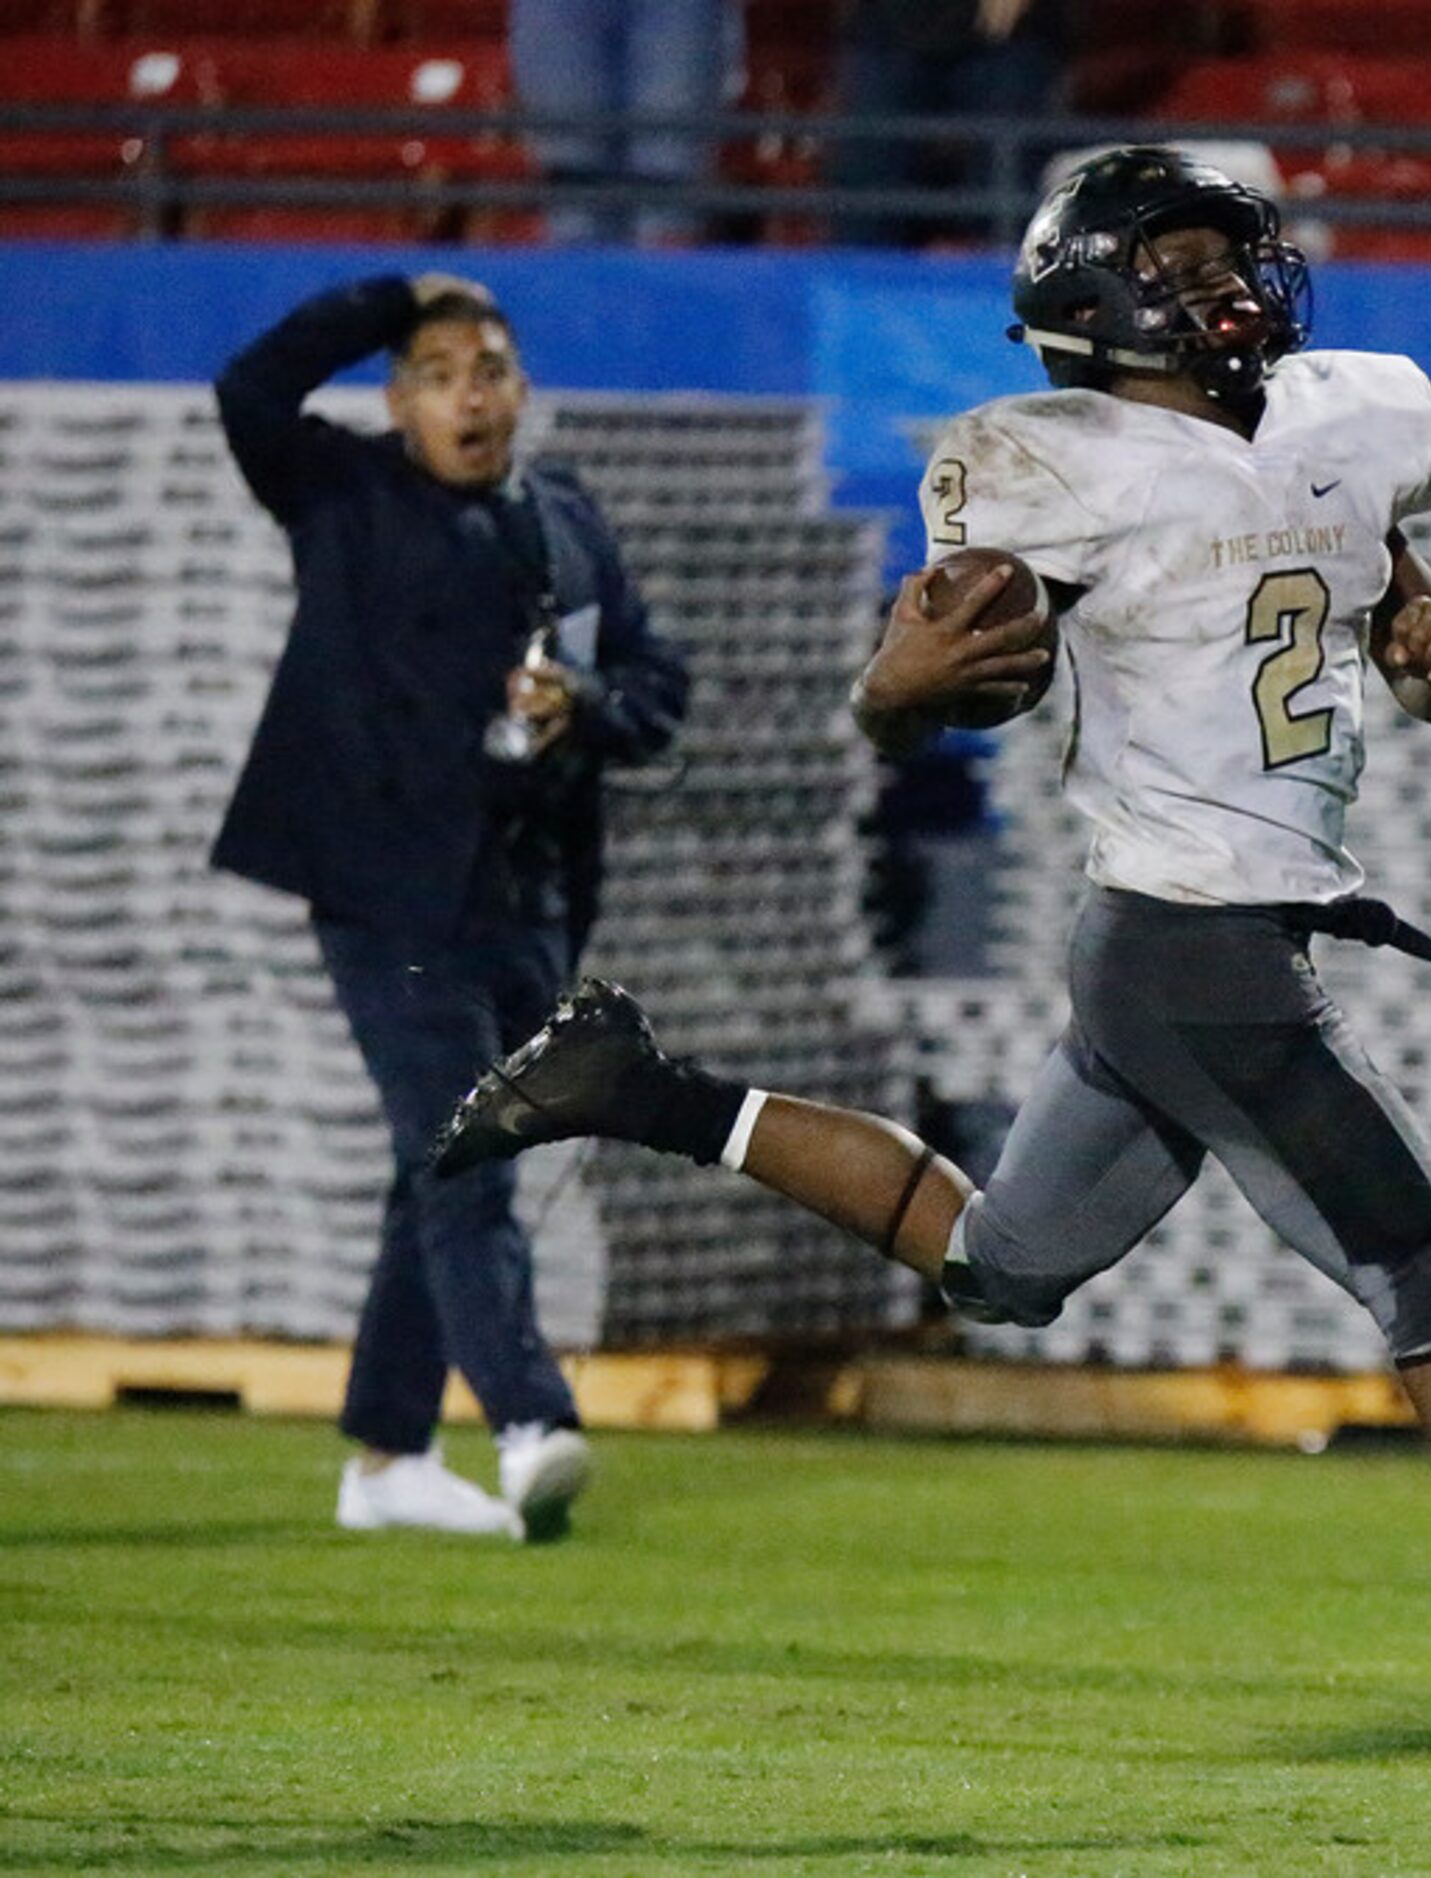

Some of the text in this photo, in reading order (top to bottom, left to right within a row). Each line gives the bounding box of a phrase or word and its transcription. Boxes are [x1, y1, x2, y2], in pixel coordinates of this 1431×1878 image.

[931, 457, 968, 545] 2
[1209, 524, 1345, 568] THE COLONY
[1244, 567, 1336, 772] 2
